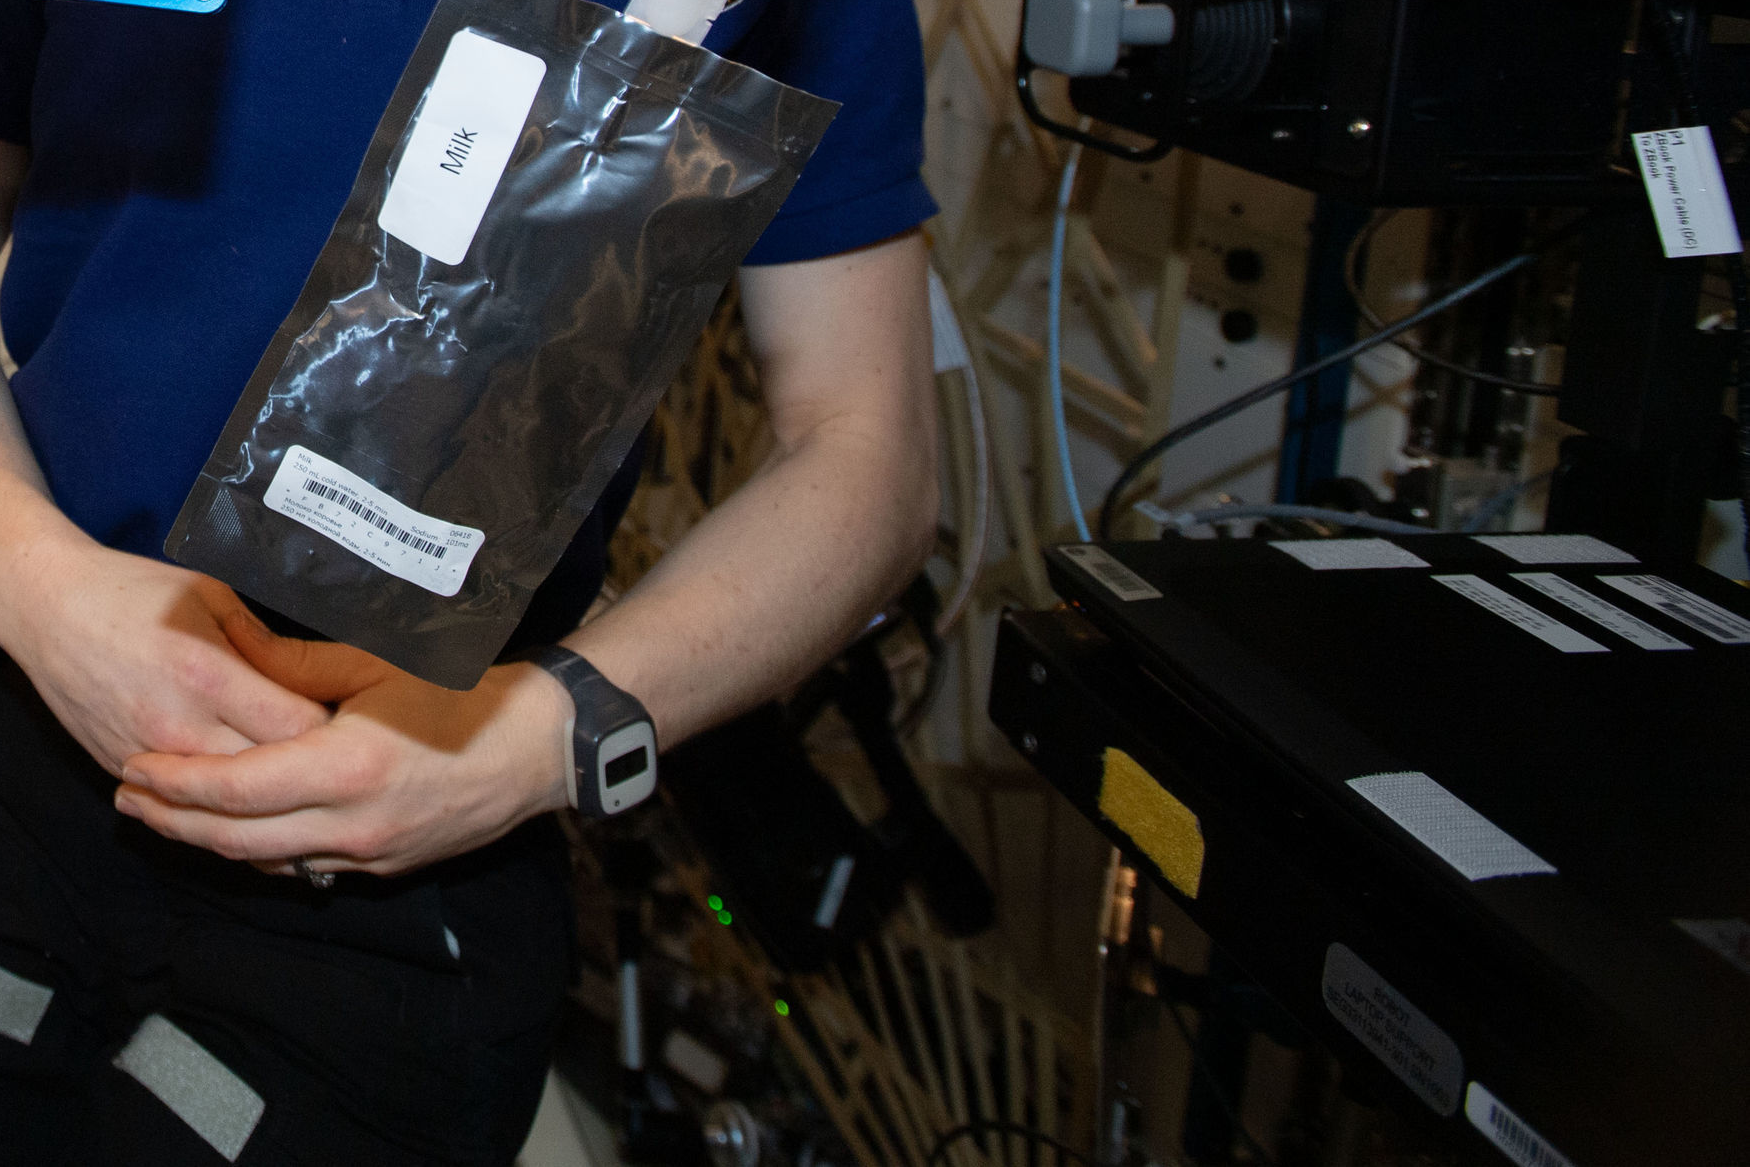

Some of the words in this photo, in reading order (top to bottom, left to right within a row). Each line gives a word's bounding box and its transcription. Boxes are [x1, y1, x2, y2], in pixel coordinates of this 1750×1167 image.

[439, 125, 479, 177] Milk
[1639, 135, 1652, 147] To
[1654, 132, 1673, 163] ZBook
[1642, 148, 1662, 179] ZBook
[1665, 165, 1681, 195] Power
[1672, 197, 1690, 225] Cable
[1678, 227, 1699, 250] (DC)
[297, 453, 312, 465] Milk
[293, 462, 308, 473] 250
[309, 469, 319, 479] mL
[321, 475, 338, 486] cold
[361, 496, 374, 507] 2-5
[374, 504, 388, 516] min
[284, 497, 312, 513] Молоко
[280, 504, 295, 514] 250
[307, 517, 341, 537] холодной
[363, 548, 376, 559] 2-5
